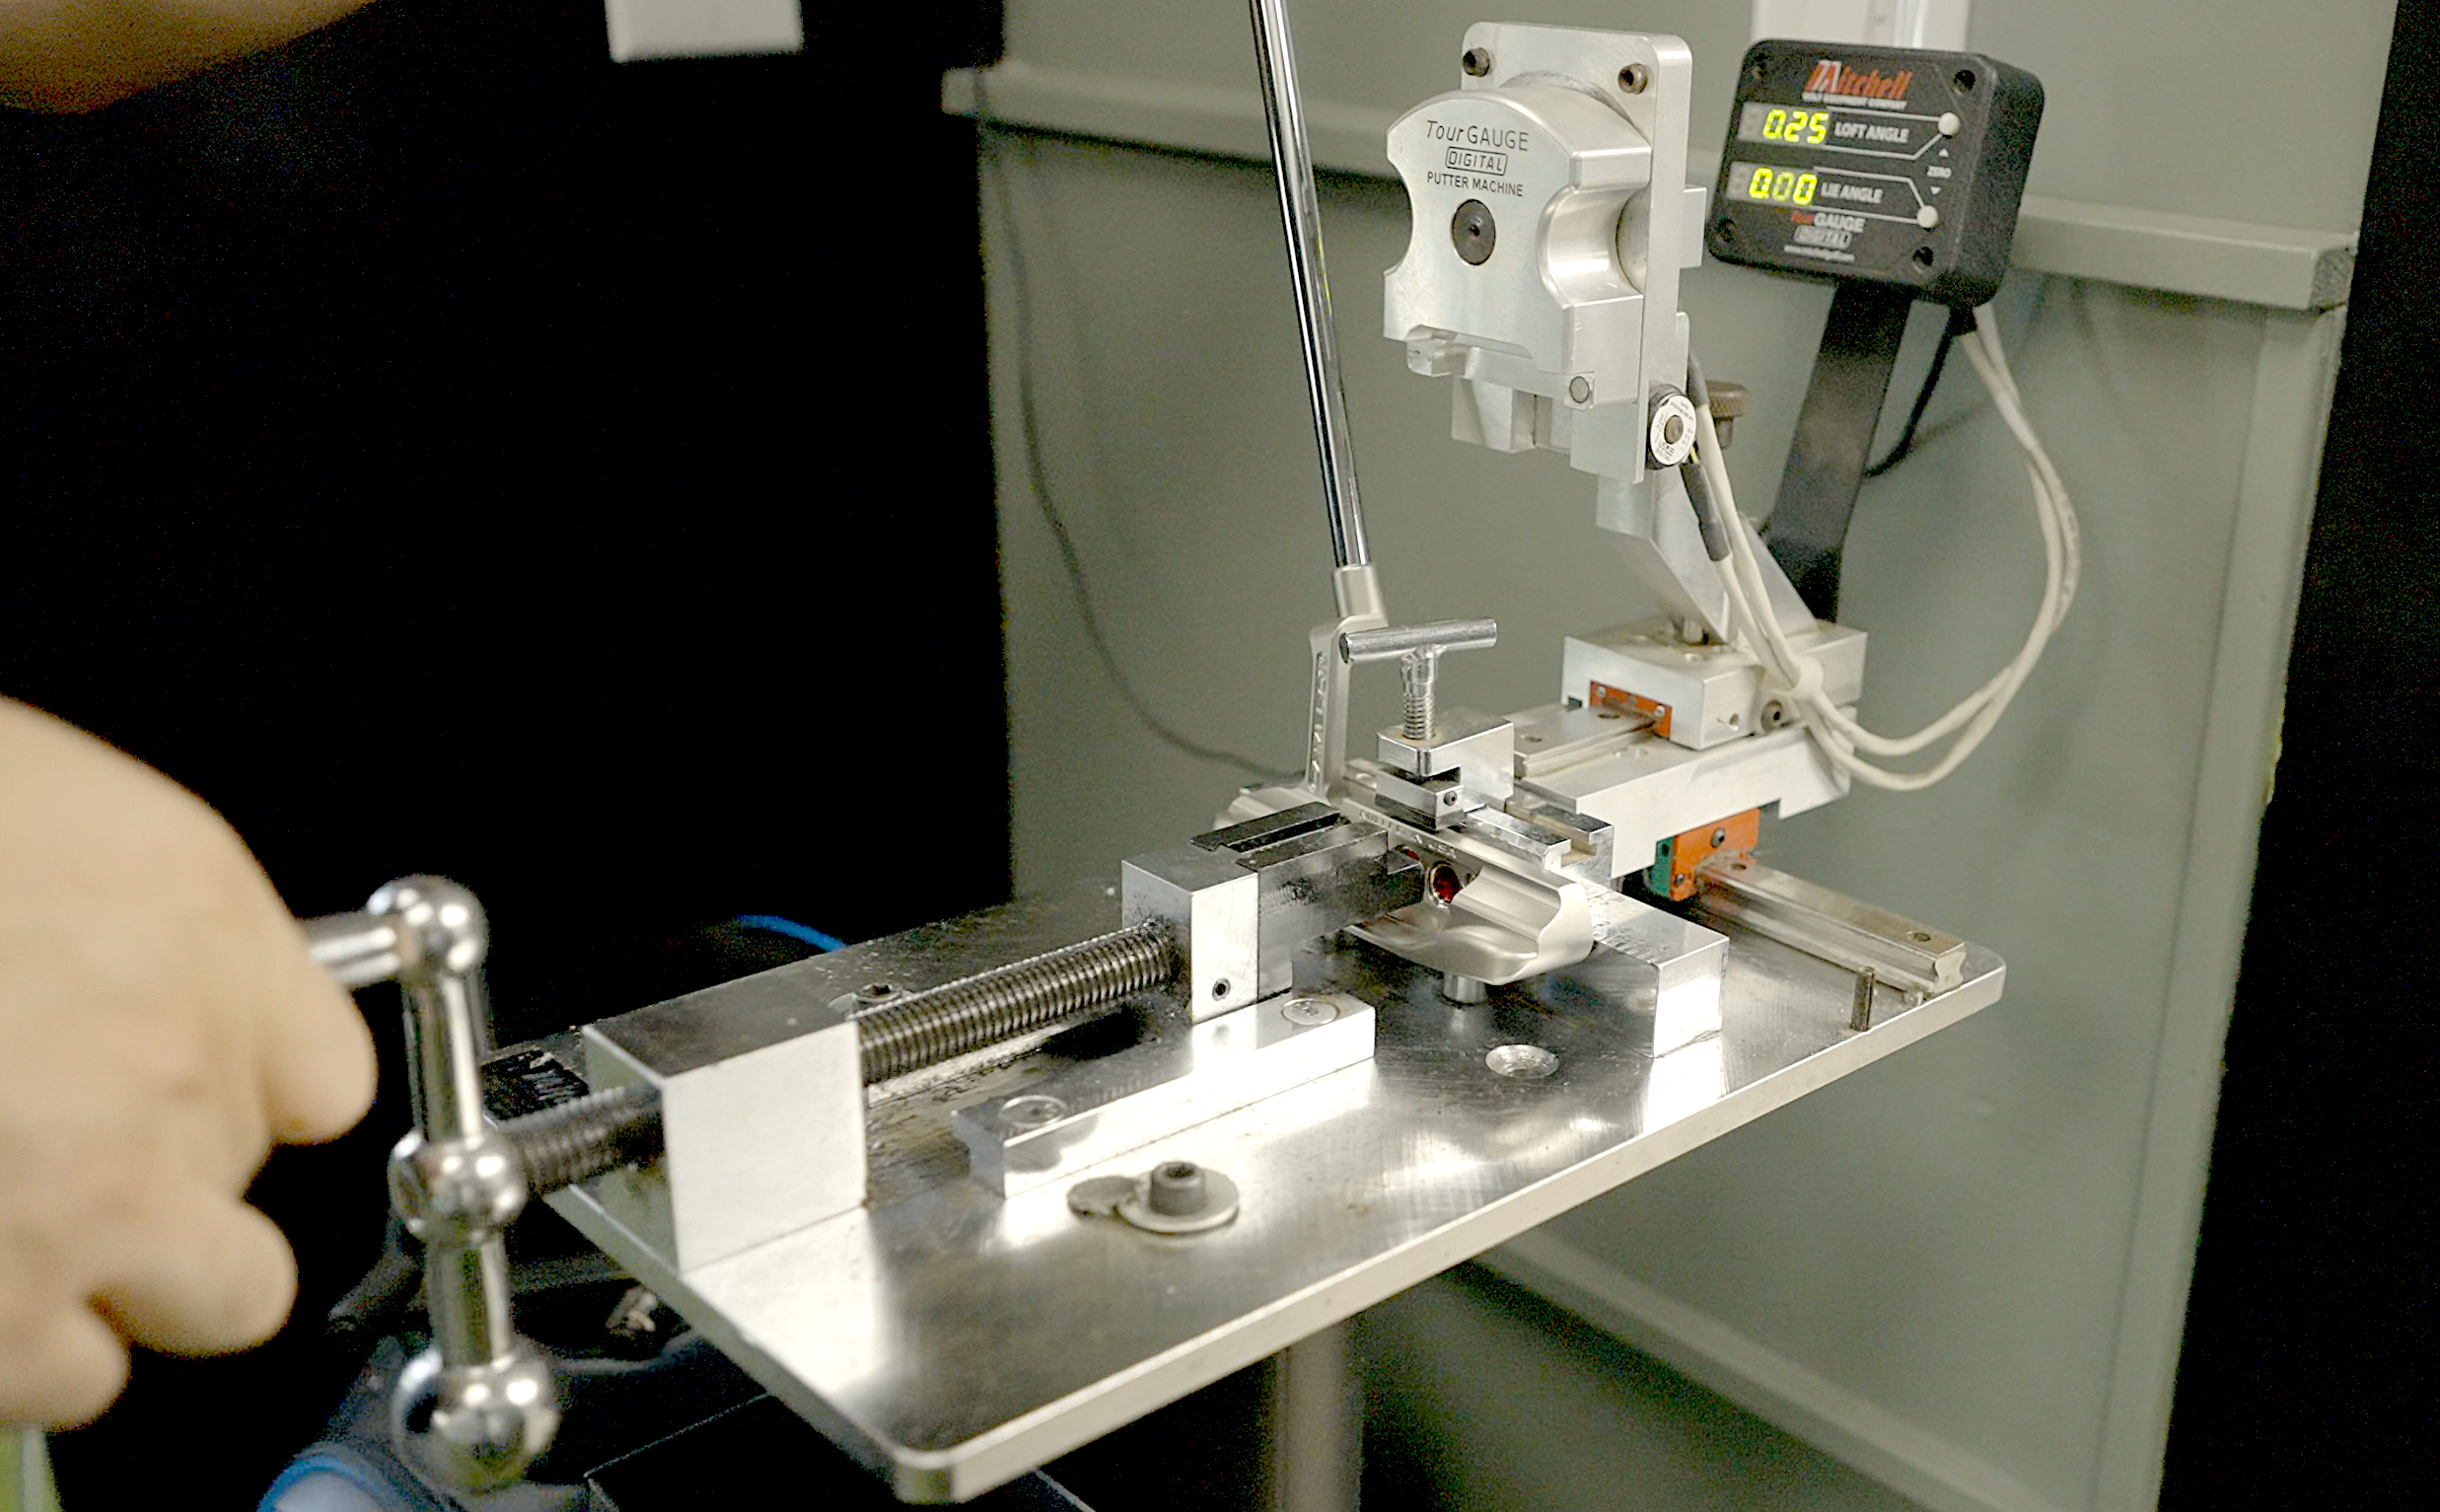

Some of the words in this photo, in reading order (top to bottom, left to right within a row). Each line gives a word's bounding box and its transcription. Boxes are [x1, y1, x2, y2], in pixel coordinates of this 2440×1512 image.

[1805, 60, 1912, 99] Mitchell
[1833, 121, 1866, 138] LOFT
[1868, 125, 1910, 144] ANGLE
[1448, 150, 1503, 172] DIGITAL
[1927, 166, 1952, 179] ZERO
[1427, 171, 1469, 189] PUTTER
[1471, 178, 1524, 197] MACHINE
[1821, 181, 1839, 199] LIE
[1840, 184, 1885, 204] ANGLE
